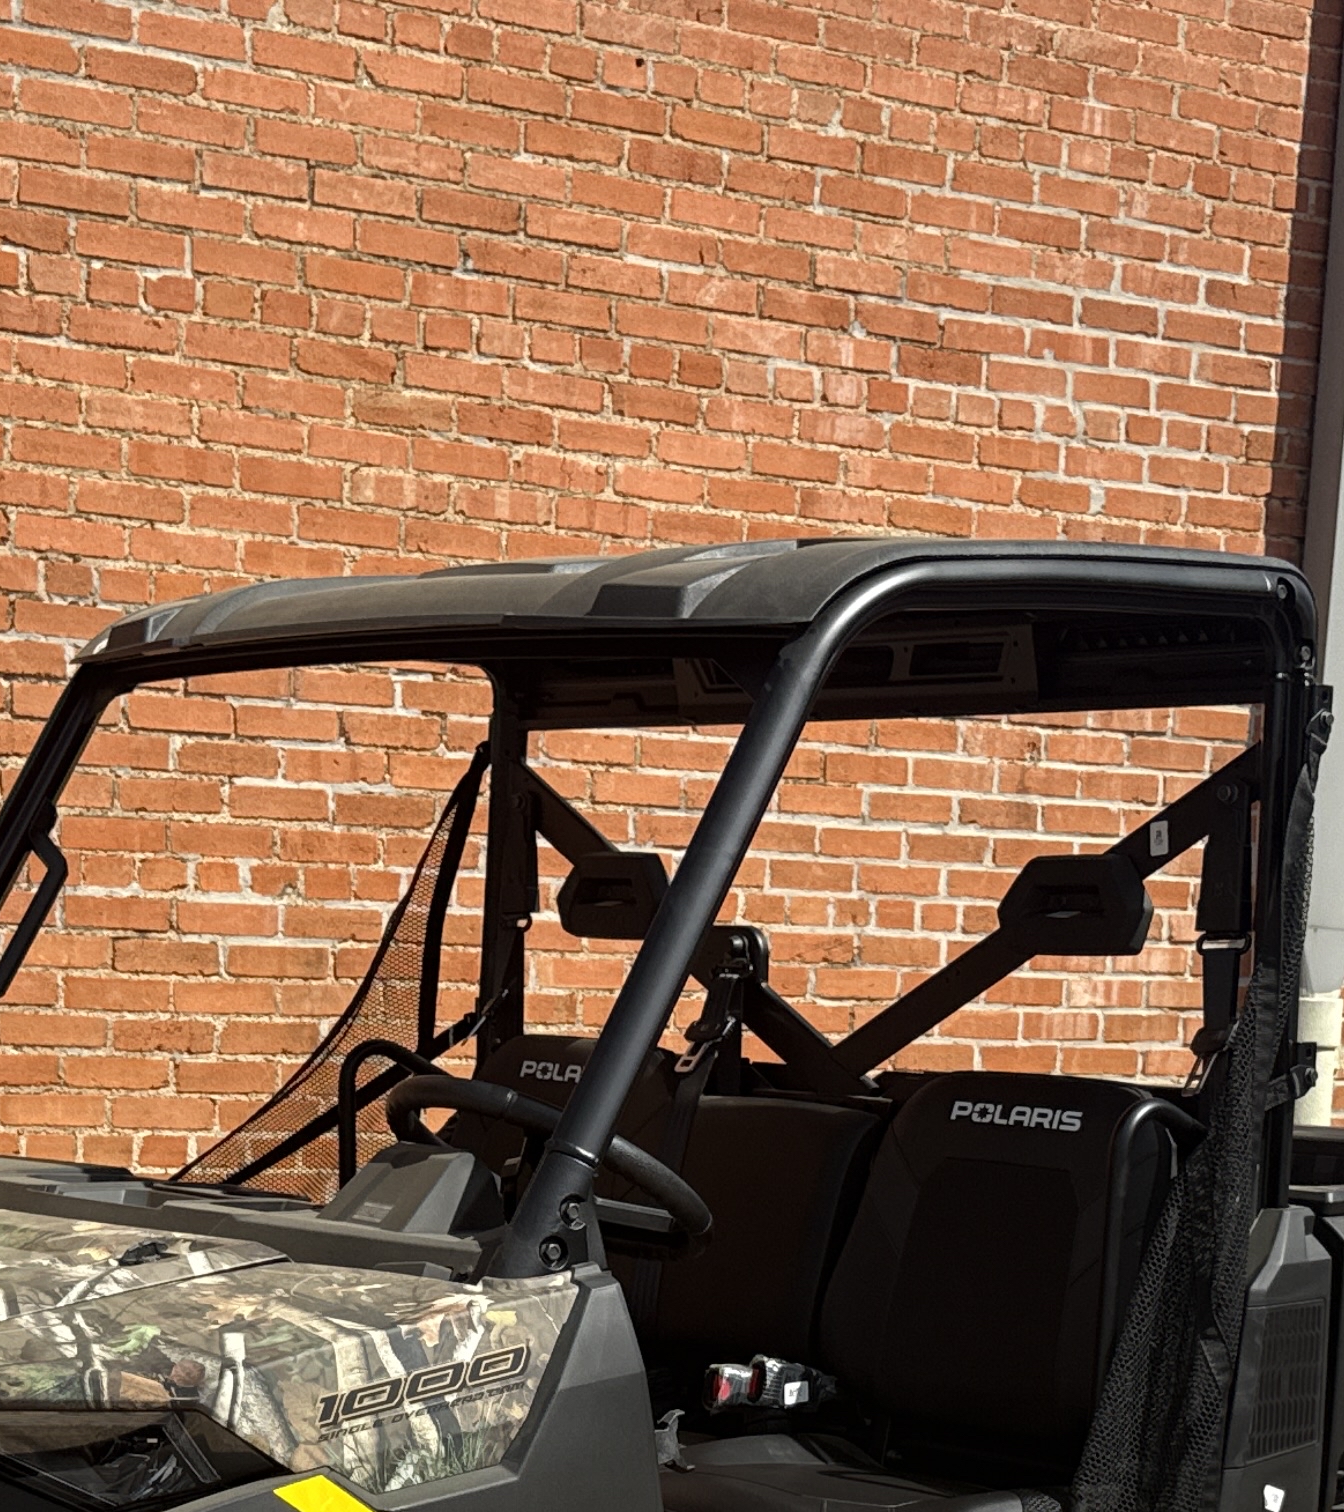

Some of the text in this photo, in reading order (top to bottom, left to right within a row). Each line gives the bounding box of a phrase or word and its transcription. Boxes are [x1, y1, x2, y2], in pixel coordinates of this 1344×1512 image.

[519, 1060, 584, 1084] POLA
[950, 1100, 1084, 1132] POLARIS
[316, 1341, 532, 1428] 1000
[317, 1419, 386, 1443] SINGLE
